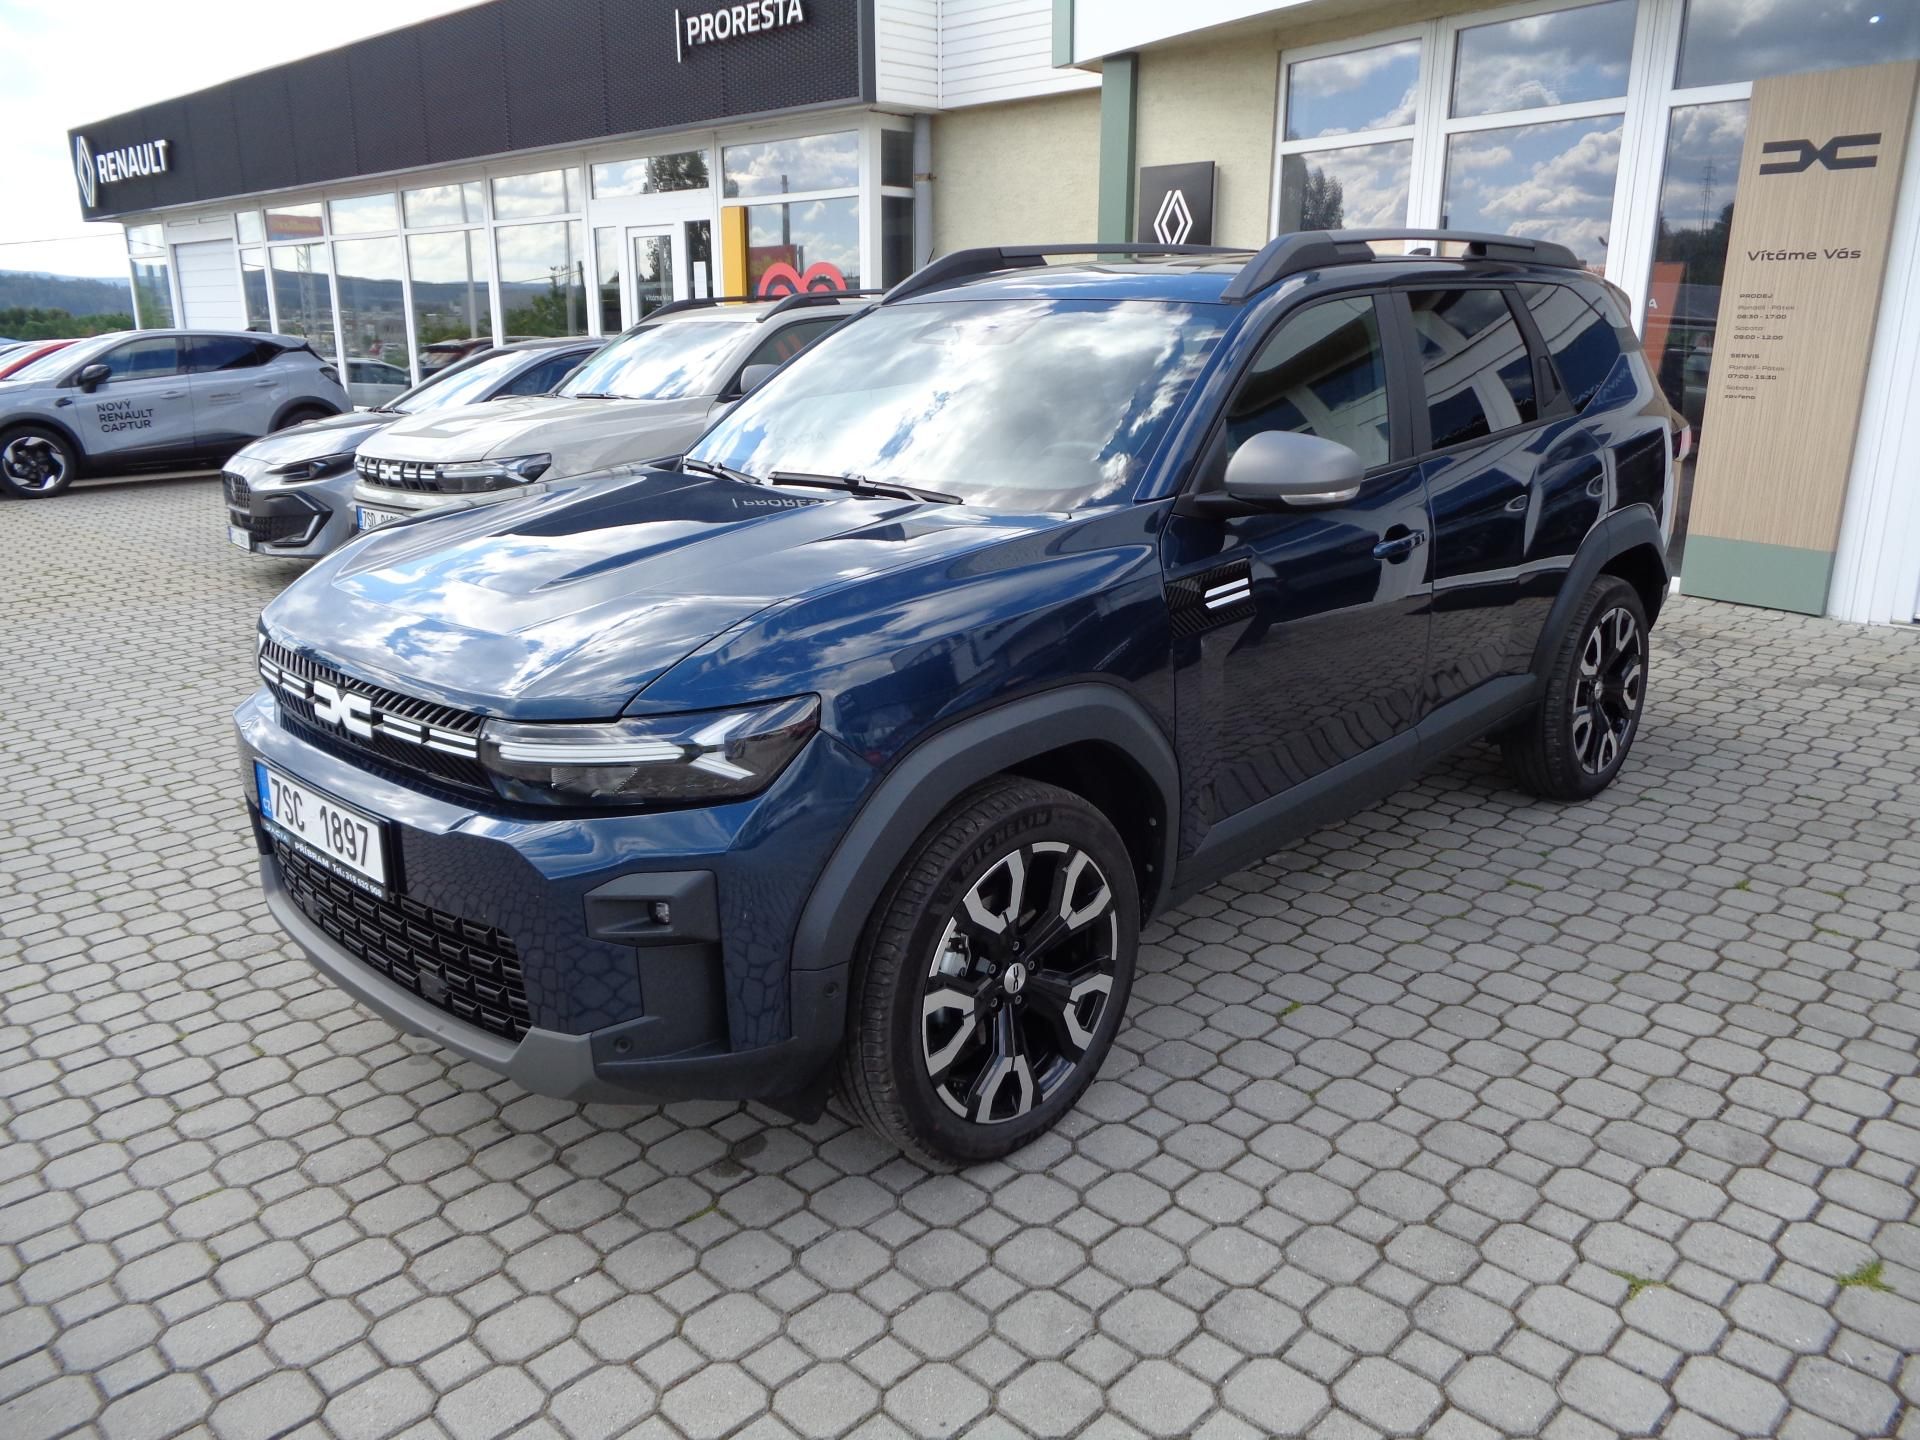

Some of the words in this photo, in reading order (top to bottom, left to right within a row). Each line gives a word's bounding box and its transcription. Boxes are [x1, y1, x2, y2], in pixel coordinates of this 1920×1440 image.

[686, 0, 804, 46] PRORESTA
[96, 139, 168, 184] RENAULT
[1747, 249, 1817, 261] Vítáme
[1823, 247, 1862, 259] Vás
[96, 398, 131, 413] NOVÝ
[99, 408, 154, 423] RENAULT
[101, 419, 152, 433] CAPTUR
[270, 778, 305, 833] 7SC
[319, 805, 369, 867] 1897
[958, 808, 1051, 877] MICHELIN
